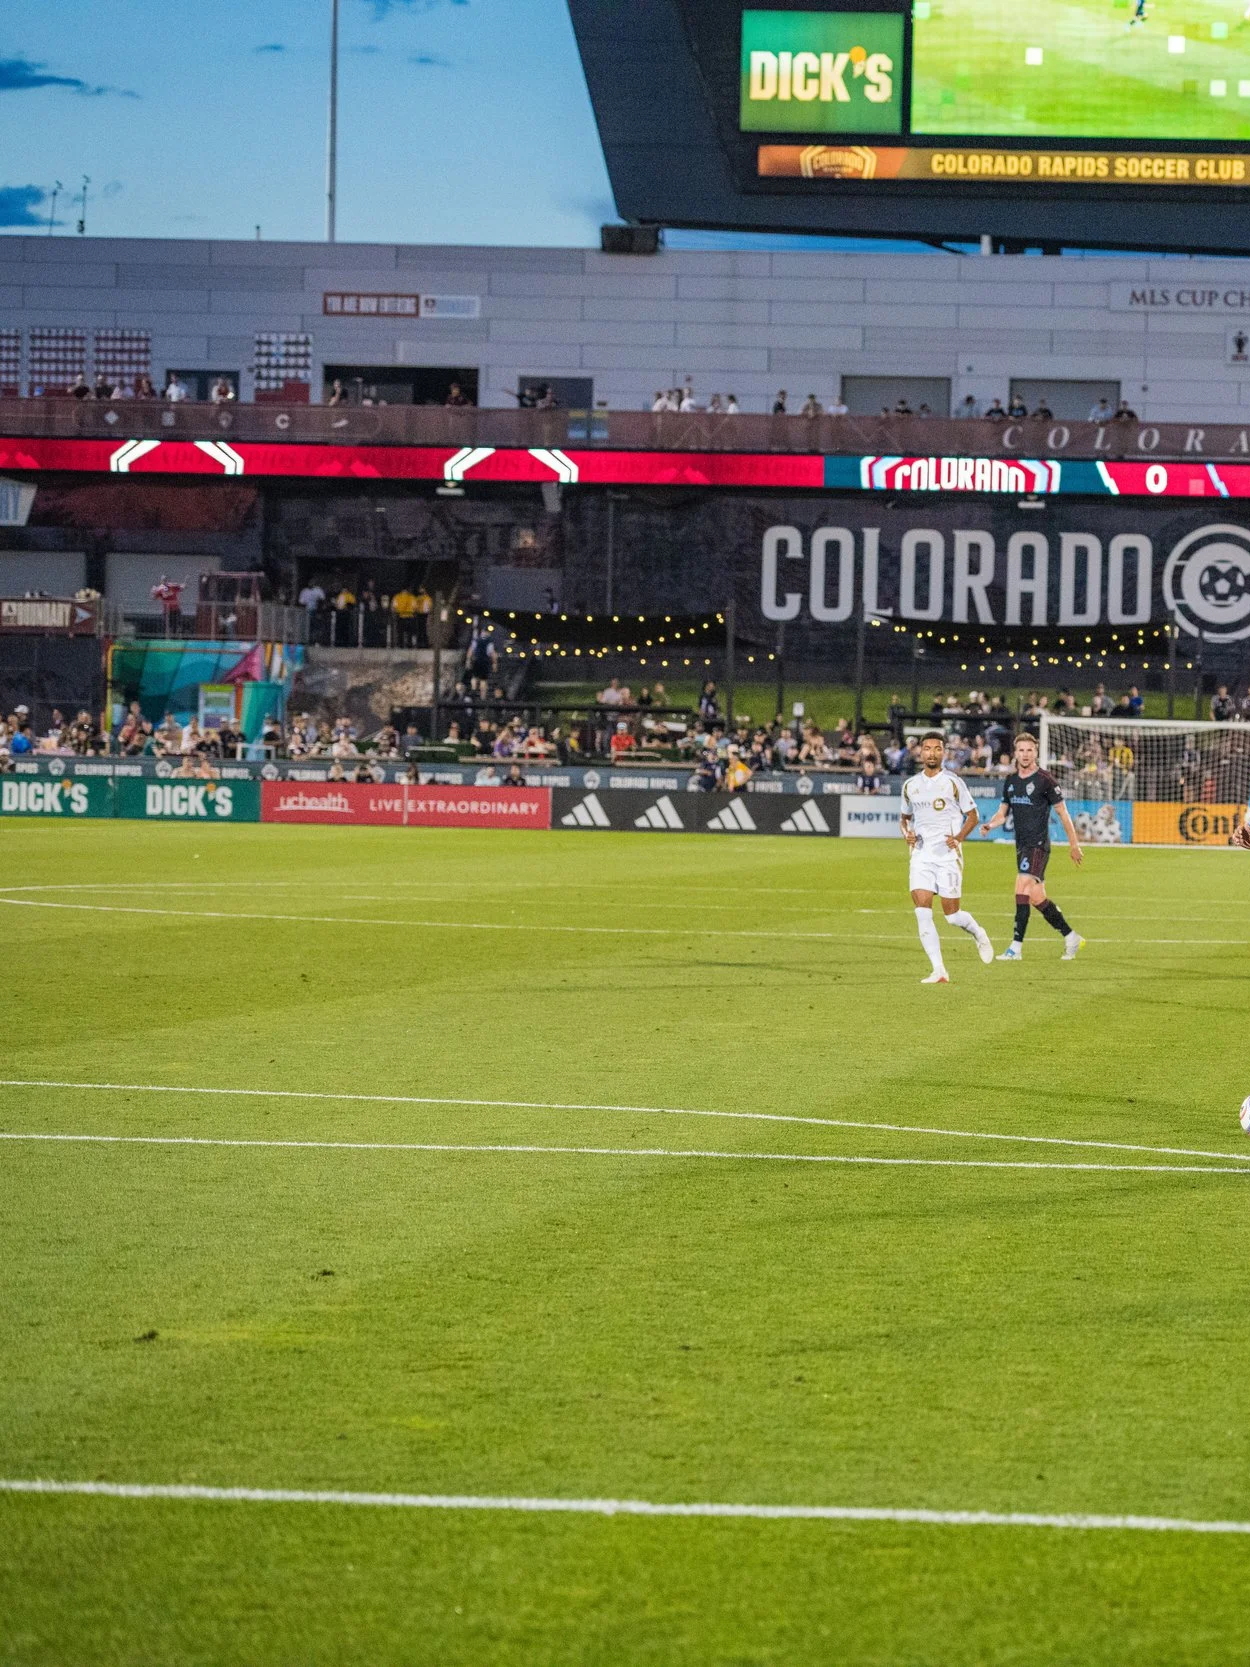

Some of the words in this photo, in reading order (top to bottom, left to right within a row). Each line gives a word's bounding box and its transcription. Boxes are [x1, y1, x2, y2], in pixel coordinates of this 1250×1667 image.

[749, 50, 893, 104] DICK'S
[931, 153, 1032, 176] COLORADO
[1038, 155, 1109, 178] RAPIDS
[1114, 156, 1190, 180] SOCCER
[1195, 157, 1246, 181] CLUB
[1128, 288, 1170, 306] MLS
[1175, 289, 1219, 307] CUP
[894, 457, 1026, 493] COLORADO
[1146, 464, 1168, 494] 0
[760, 525, 1153, 627] COLORADO
[2, 781, 89, 814] DICK'S
[146, 784, 233, 817] DICK'S
[279, 793, 349, 811] uchealth
[369, 799, 402, 812] LIVE
[407, 800, 540, 815] EXTRAORDINARY
[848, 812, 880, 823] ENJOY
[885, 812, 900, 822] TH
[1020, 857, 1030, 871] 6
